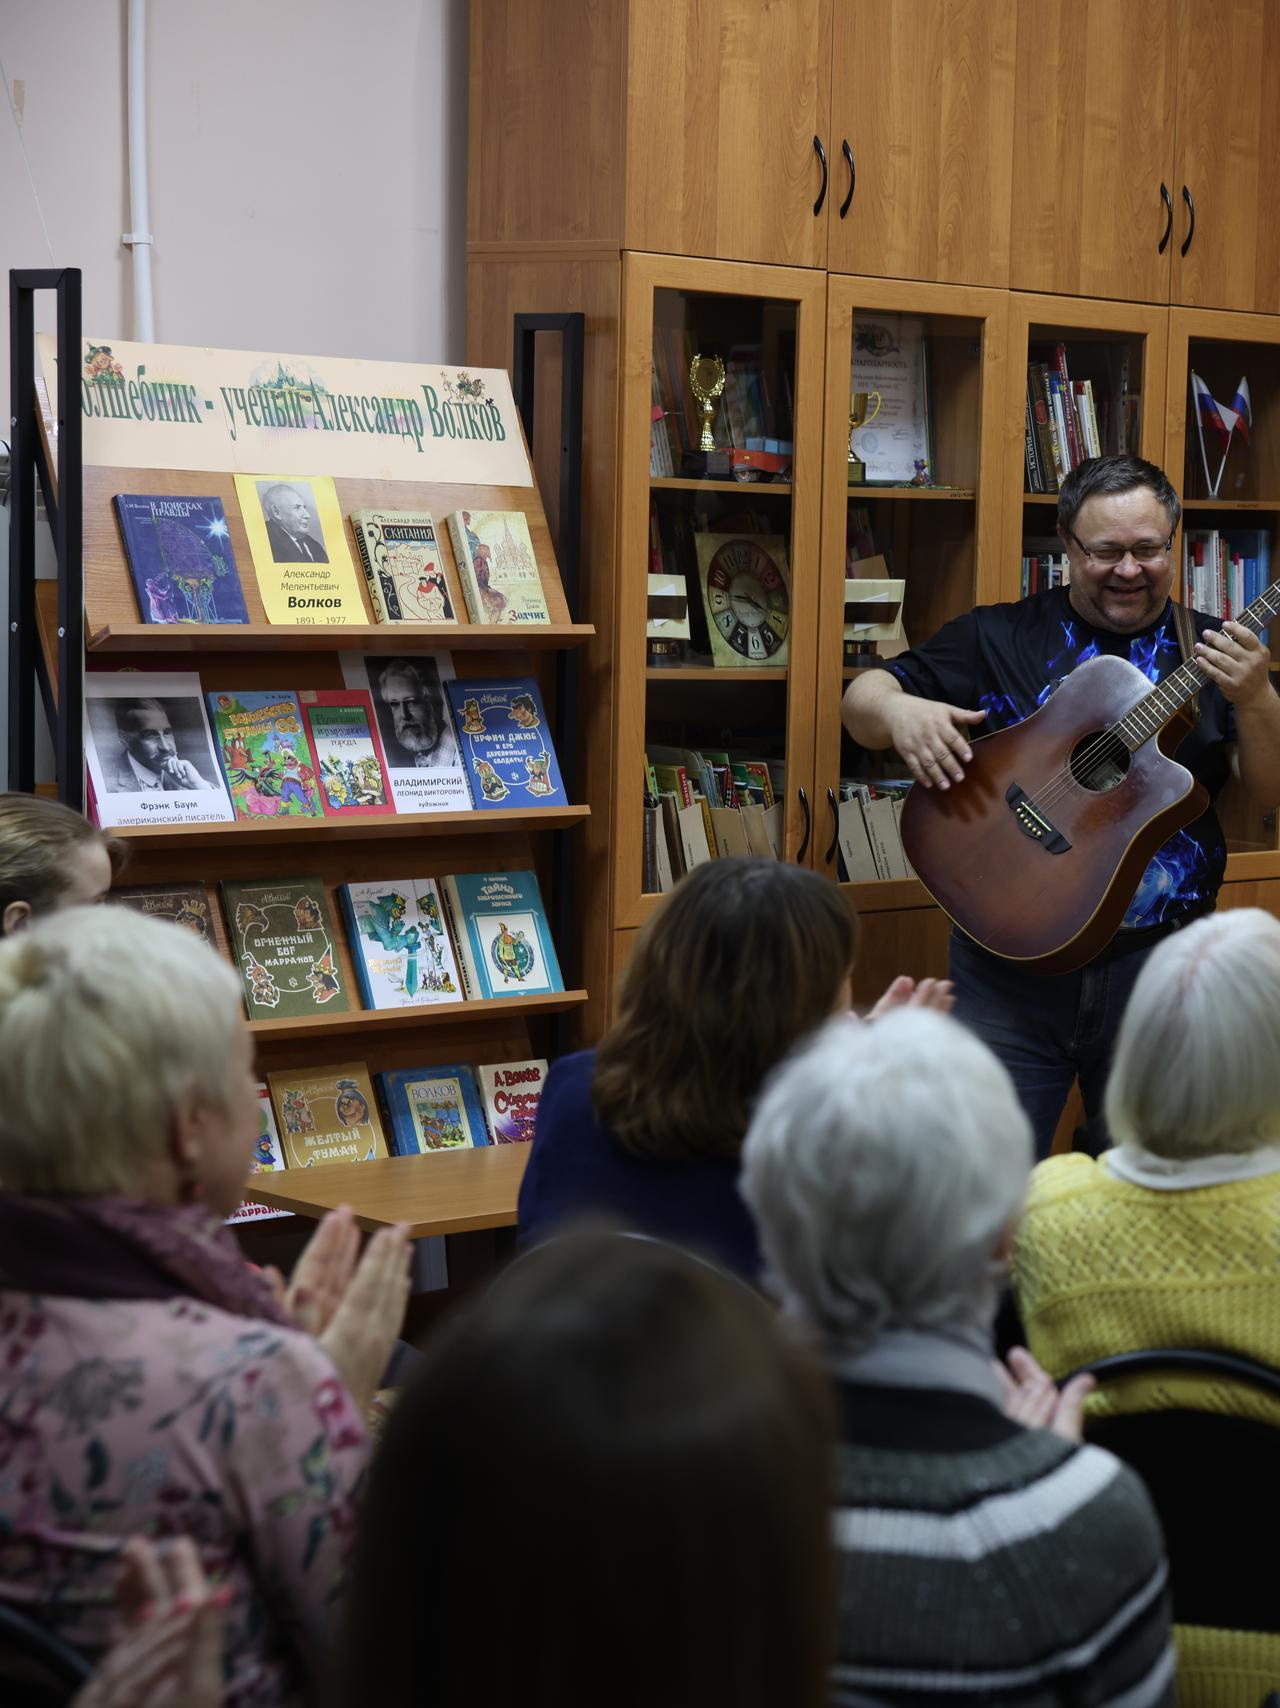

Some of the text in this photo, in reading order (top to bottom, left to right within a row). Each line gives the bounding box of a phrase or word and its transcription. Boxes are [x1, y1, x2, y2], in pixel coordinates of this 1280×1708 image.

[81, 364, 203, 424] олшебник
[219, 373, 306, 441] ученый
[309, 377, 424, 453] Александр
[421, 384, 506, 441] Волков
[1026, 436, 1037, 470] ИСТОРИЯ
[163, 501, 203, 510] ПОИСКАХ
[152, 509, 190, 517] ПРАВДЫ
[384, 527, 433, 540] СКИТАНИЯ
[283, 569, 331, 579] Александр
[280, 582, 340, 591] Мелентьевич
[288, 596, 342, 608] Волков
[473, 732, 537, 743] УРФИН ДЖЮС
[394, 777, 463, 787] ВЛАДИМИРСКИЙ
[140, 800, 198, 811] Фрэнк Баум
[117, 814, 226, 825] американский писатель
[254, 932, 314, 948] ОГНЕННЫЙ
[276, 946, 296, 956] БОГ
[264, 956, 314, 967] МАРРАНОВ
[412, 1085, 457, 1099] ВОЛКОВ
[304, 1128, 361, 1146] ЖЕЛТЫЙ
[312, 1144, 358, 1159] ТУМАН
